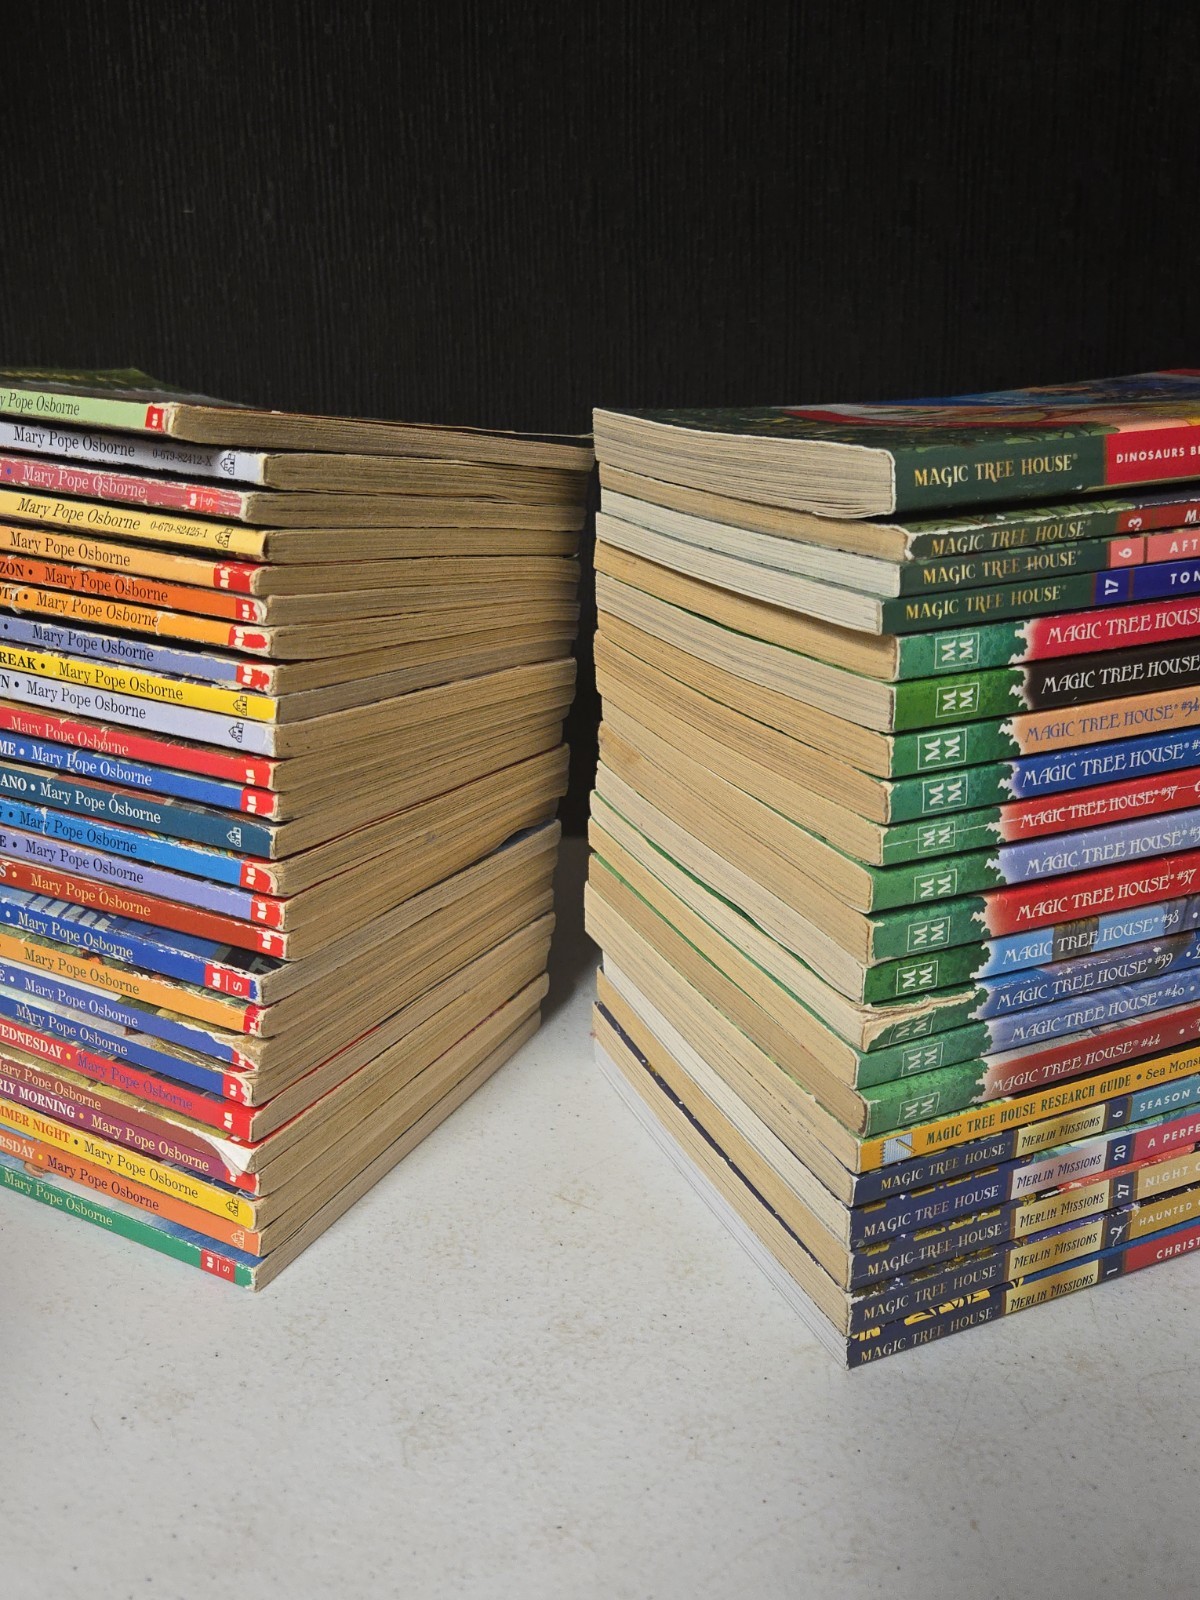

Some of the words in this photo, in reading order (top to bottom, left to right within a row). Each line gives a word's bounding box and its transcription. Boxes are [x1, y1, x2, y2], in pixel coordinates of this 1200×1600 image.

[8, 393, 33, 410] Pope
[36, 396, 79, 415] Osborne
[14, 426, 45, 447] Mary
[49, 432, 79, 450] Pope
[82, 439, 135, 457] Osborne
[1116, 447, 1184, 463] DINOSAURS
[23, 465, 55, 486] Mary
[58, 472, 88, 490] Pope
[914, 466, 968, 488] MAGIC
[975, 460, 1015, 482] TREE
[17, 498, 50, 517] Mary
[53, 505, 84, 522] Pope
[88, 510, 140, 530] Osborne
[10, 532, 42, 552] Mary
[46, 538, 75, 558] Pope
[79, 546, 130, 566] Osborne
[45, 567, 77, 589] Mary
[81, 573, 111, 592] Pope
[115, 581, 168, 602] Osborne
[923, 564, 976, 584] MAGIC
[982, 559, 1020, 578] TREE
[37, 592, 68, 612] Mary
[72, 599, 102, 617] Pope
[906, 599, 958, 620] MAGIC
[966, 593, 1004, 613] TREE
[32, 625, 64, 647] Mary
[68, 632, 97, 651] Pope
[1046, 621, 1102, 644] MAGIC
[1105, 615, 1152, 636] TREE
[59, 662, 91, 684] Mary
[95, 669, 125, 689] Pope
[130, 677, 183, 700] Osborne
[1042, 670, 1095, 694] MAGIC
[1100, 663, 1145, 684] TREE
[27, 681, 57, 703] Mary
[61, 687, 91, 708] Pope
[95, 696, 145, 719] Osborne
[1025, 721, 1075, 743] MAGIC
[1079, 714, 1121, 733] TREE
[32, 746, 63, 768] Mary
[67, 754, 97, 774] Pope
[100, 762, 151, 786] Osborne
[1022, 763, 1076, 787] MAGIC
[1080, 753, 1126, 776] TREE
[40, 783, 71, 805] Mary
[75, 791, 105, 812] Pope
[109, 799, 160, 824] Osborne
[1020, 809, 1065, 828] MAGIC
[1069, 801, 1106, 819] TREE
[54, 820, 82, 840] Pope
[87, 828, 137, 854] Osborne
[26, 841, 56, 862] Mary
[60, 850, 89, 870] Pope
[93, 858, 144, 884] Osborne
[1025, 852, 1079, 876] MAGIC
[1082, 842, 1125, 864] TREE
[31, 873, 62, 895] Mary
[66, 882, 95, 902] Pope
[99, 891, 150, 917] Osborne
[1016, 898, 1067, 921] MAGIC
[1071, 887, 1114, 909] TREE
[18, 911, 48, 933] Mary
[52, 922, 80, 942] Pope
[83, 933, 133, 959] Osborne
[1003, 941, 1053, 964] MAGIC
[1057, 931, 1099, 952] TREE
[24, 947, 54, 969] Mary
[58, 957, 87, 978] Pope
[90, 968, 139, 994] Osborne
[58, 989, 86, 1009] Pope
[89, 1001, 138, 1027] Osborne
[997, 985, 1048, 1010] MAGIC
[1052, 974, 1094, 994] TREE
[48, 1014, 76, 1035] Pope
[80, 1026, 128, 1055] Osborne
[1010, 1018, 1061, 1042] MAGIC
[1064, 1006, 1105, 1028] TREE
[78, 1053, 107, 1077] Mary
[111, 1066, 139, 1088] Pope
[144, 1078, 193, 1109] Osborne
[990, 1069, 1038, 1094] MAGIC
[1042, 1056, 1081, 1079] TREE
[55, 1081, 101, 1111] Osborne
[926, 1124, 962, 1146] MAGIC
[967, 1114, 995, 1132] TREE
[1000, 1104, 1036, 1123] HOUSE
[1041, 1085, 1095, 1111] RESEARCH
[1100, 1075, 1131, 1093] GUIDE
[1146, 1068, 1166, 1080] Sea
[1140, 1089, 1190, 1112] SEASON
[19, 1085, 75, 1119] MORNING
[92, 1114, 121, 1140] Mary
[125, 1130, 155, 1152] Pope
[159, 1141, 209, 1172] Osborne
[33, 1116, 70, 1144] NIGHT
[84, 1140, 113, 1165] Mary
[117, 1154, 145, 1177] Pope
[150, 1166, 198, 1198] Osborne
[881, 1168, 923, 1191] MAGIC
[929, 1156, 959, 1176] TREE
[47, 1155, 76, 1179] Mary
[80, 1168, 107, 1190] Pope
[111, 1181, 159, 1211] Osborne
[1145, 1166, 1188, 1188] NIGHT
[4, 1169, 32, 1194] Mary
[36, 1184, 62, 1206] Pope
[66, 1198, 113, 1226] Osborne
[1139, 1202, 1192, 1227] HAUNTED
[864, 1212, 911, 1238] MAGIC
[915, 1201, 950, 1219] TREE
[868, 1252, 914, 1276] MAGIC
[919, 1239, 952, 1259] TREE
[864, 1295, 909, 1321] MAGIC
[915, 1283, 948, 1303] TREE
[861, 1337, 906, 1363] MAGIC
[911, 1324, 944, 1344] TREE
